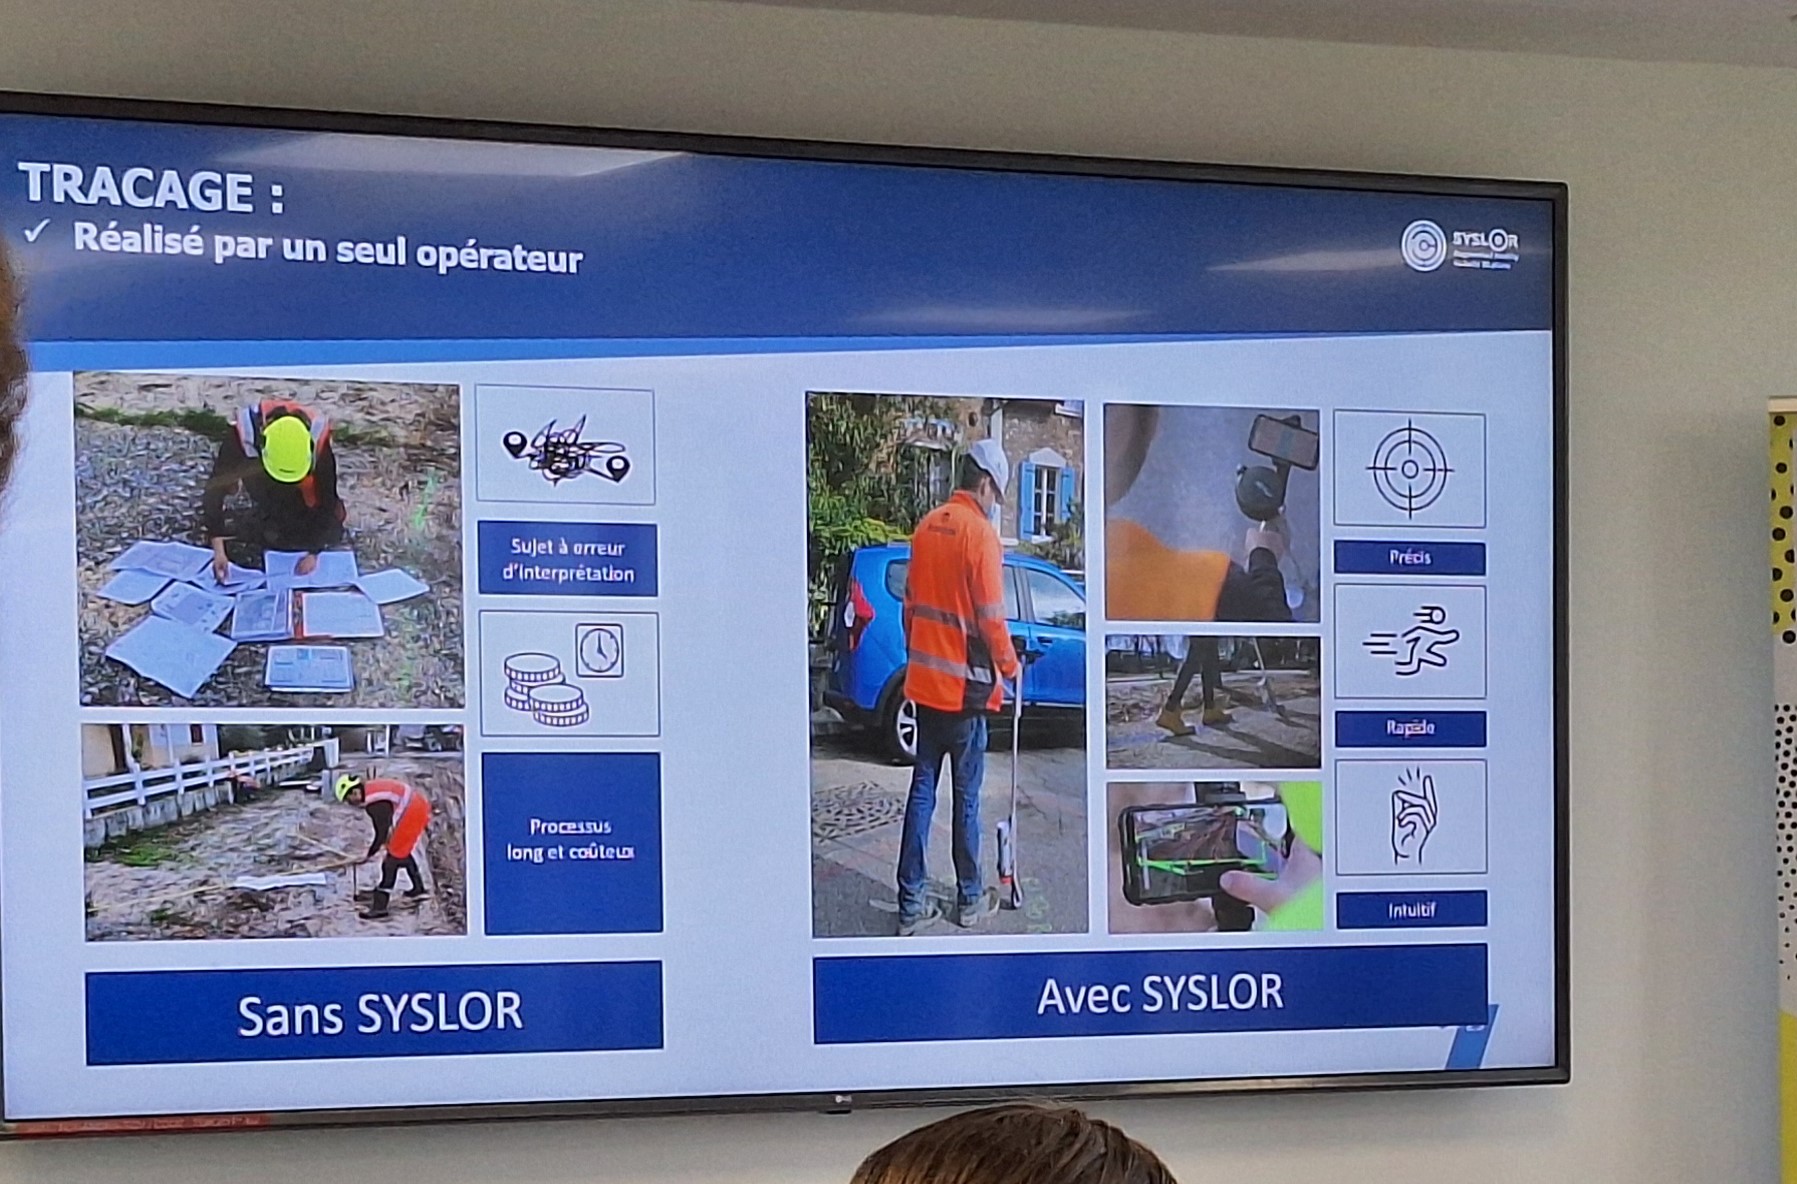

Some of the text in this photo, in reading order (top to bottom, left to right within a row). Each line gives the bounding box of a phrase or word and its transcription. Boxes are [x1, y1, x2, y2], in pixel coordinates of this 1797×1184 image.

[18, 162, 284, 213] TRACAGE :
[74, 220, 584, 274] Réalisé par un seul opérateur
[511, 537, 553, 557] Sujet
[558, 537, 569, 555] à
[1389, 547, 1432, 565] Précis
[1386, 718, 1436, 740] Rapide
[530, 818, 612, 836] Processus
[507, 841, 635, 864] long et coûteux
[1388, 901, 1437, 919] Intuitif
[1037, 973, 1284, 1015] Avec SYSLOR
[238, 991, 523, 1037] Sans SYSLOR
